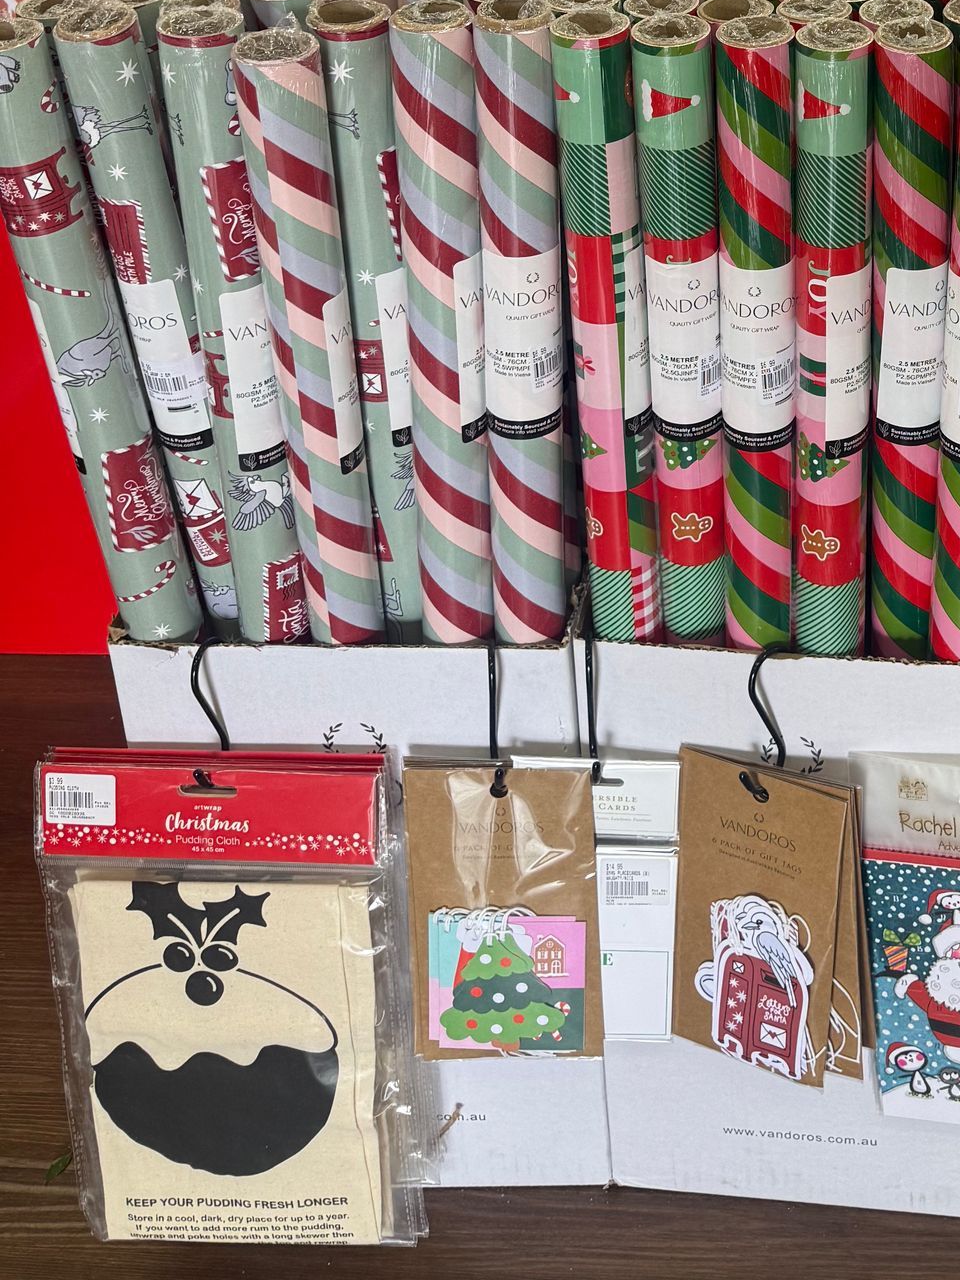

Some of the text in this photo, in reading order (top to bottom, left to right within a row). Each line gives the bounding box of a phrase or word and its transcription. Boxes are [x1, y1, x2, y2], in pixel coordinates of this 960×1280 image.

[486, 283, 561, 307] VANDOR
[808, 260, 831, 321] JOY
[649, 289, 720, 313] VANDOR
[889, 296, 947, 318] VANDO
[730, 323, 750, 333] QUALITY
[730, 359, 756, 370] METRES
[910, 358, 937, 366] METRES
[140, 465, 168, 521] Christmas
[194, 804, 222, 812] artwrap
[598, 803, 636, 812] CARDS
[165, 813, 249, 833] Christmas
[457, 821, 544, 834] VANDOROS
[899, 812, 957, 837] Rachel
[175, 834, 240, 847] Pudding Cloth
[720, 816, 796, 853] VANDOROS
[720, 840, 741, 851] PACK
[745, 847, 755, 855] OF
[760, 852, 778, 864] GIFT
[782, 860, 802, 874] TAGS
[764, 1011, 787, 1025] SANTA
[723, 1127, 878, 1147] www.vandoros.com.au
[126, 1197, 348, 1209] KEEP YOUR PUDDING FRESH LONGER
[128, 1213, 153, 1222] Store
[156, 1214, 164, 1222] in
[175, 1214, 198, 1223] cool,
[201, 1214, 225, 1223] dark,
[228, 1215, 244, 1223] dry
[246, 1215, 272, 1223] place
[291, 1215, 303, 1223] up
[326, 1213, 349, 1221] year.
[271, 1223, 281, 1231] to
[284, 1223, 299, 1231] the
[301, 1222, 344, 1231] pudding,
